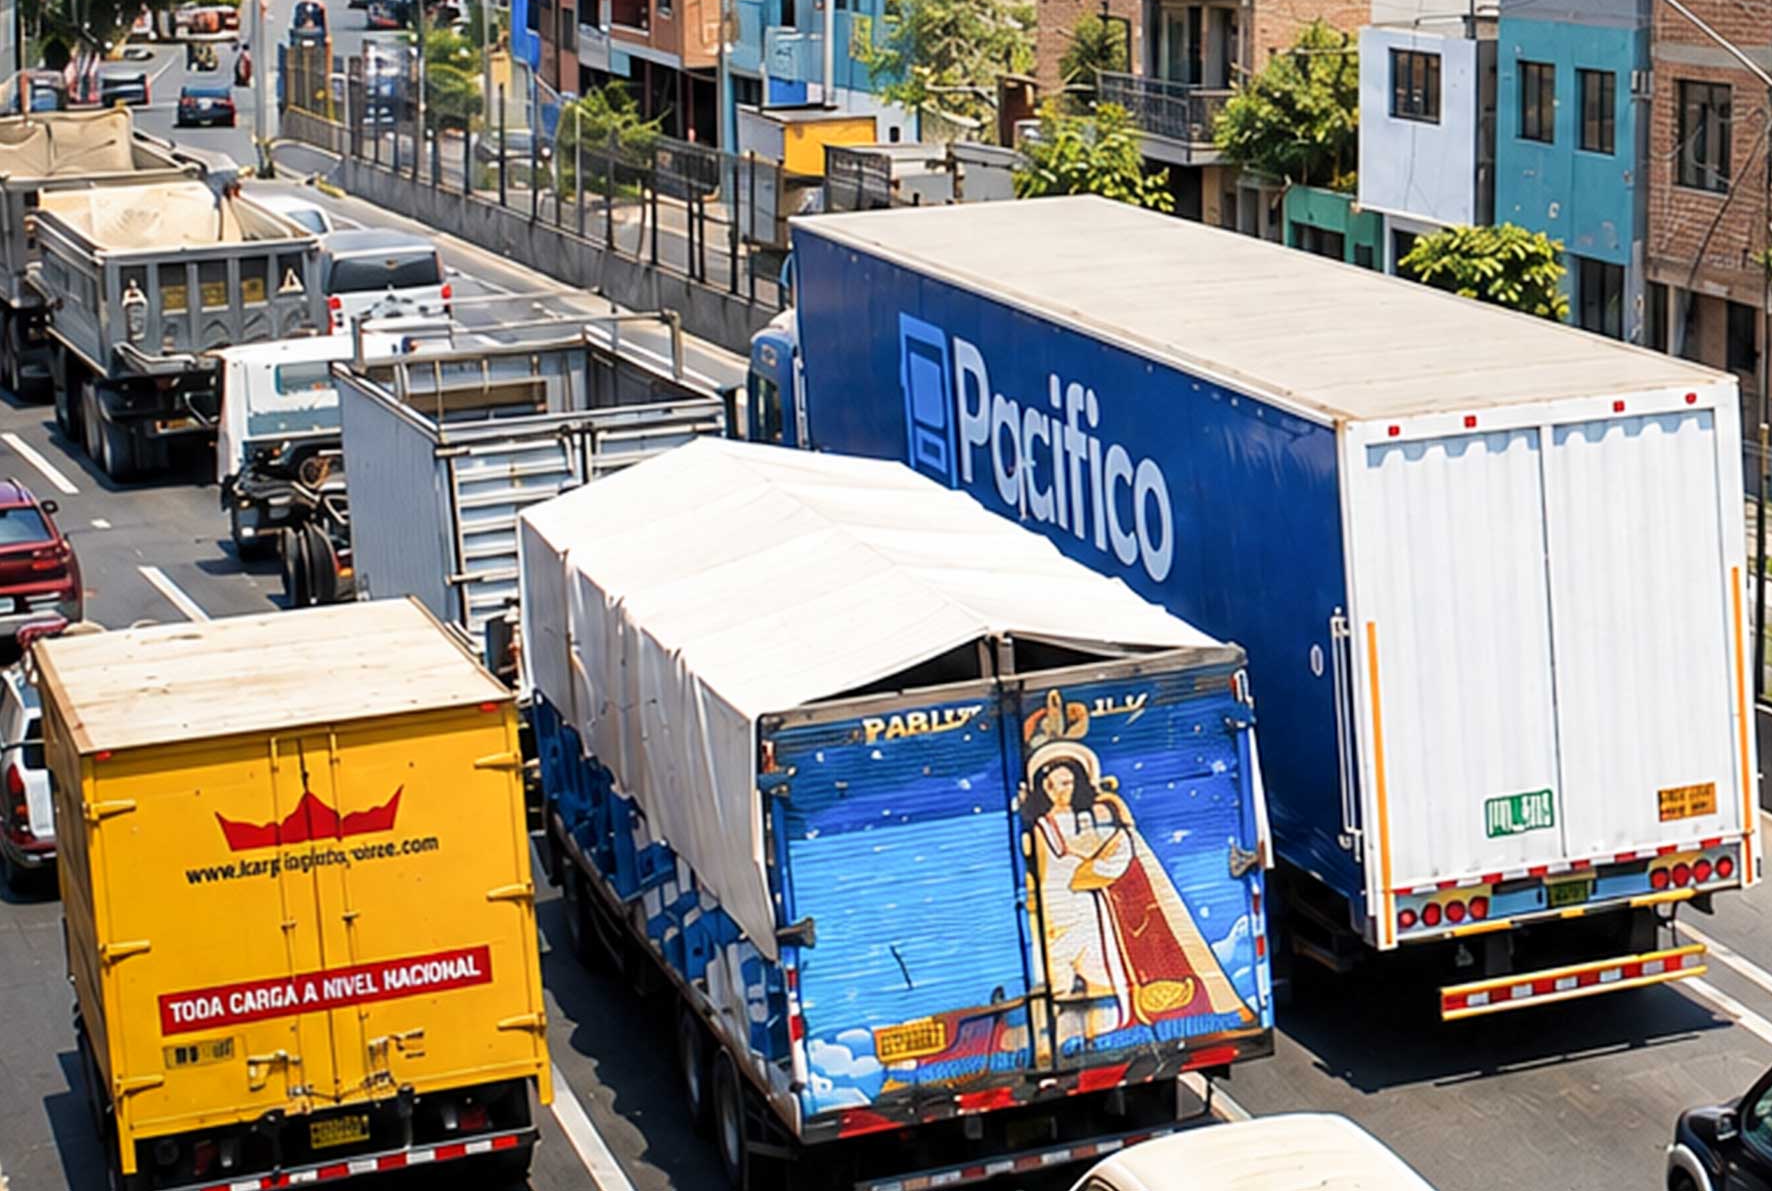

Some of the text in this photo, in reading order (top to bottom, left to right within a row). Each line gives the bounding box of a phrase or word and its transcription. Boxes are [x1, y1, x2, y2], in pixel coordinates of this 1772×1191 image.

[169, 999, 225, 1023] TODA
[229, 985, 299, 1014] CARGA
[302, 983, 318, 1004] A
[323, 973, 378, 1000] NIVEL
